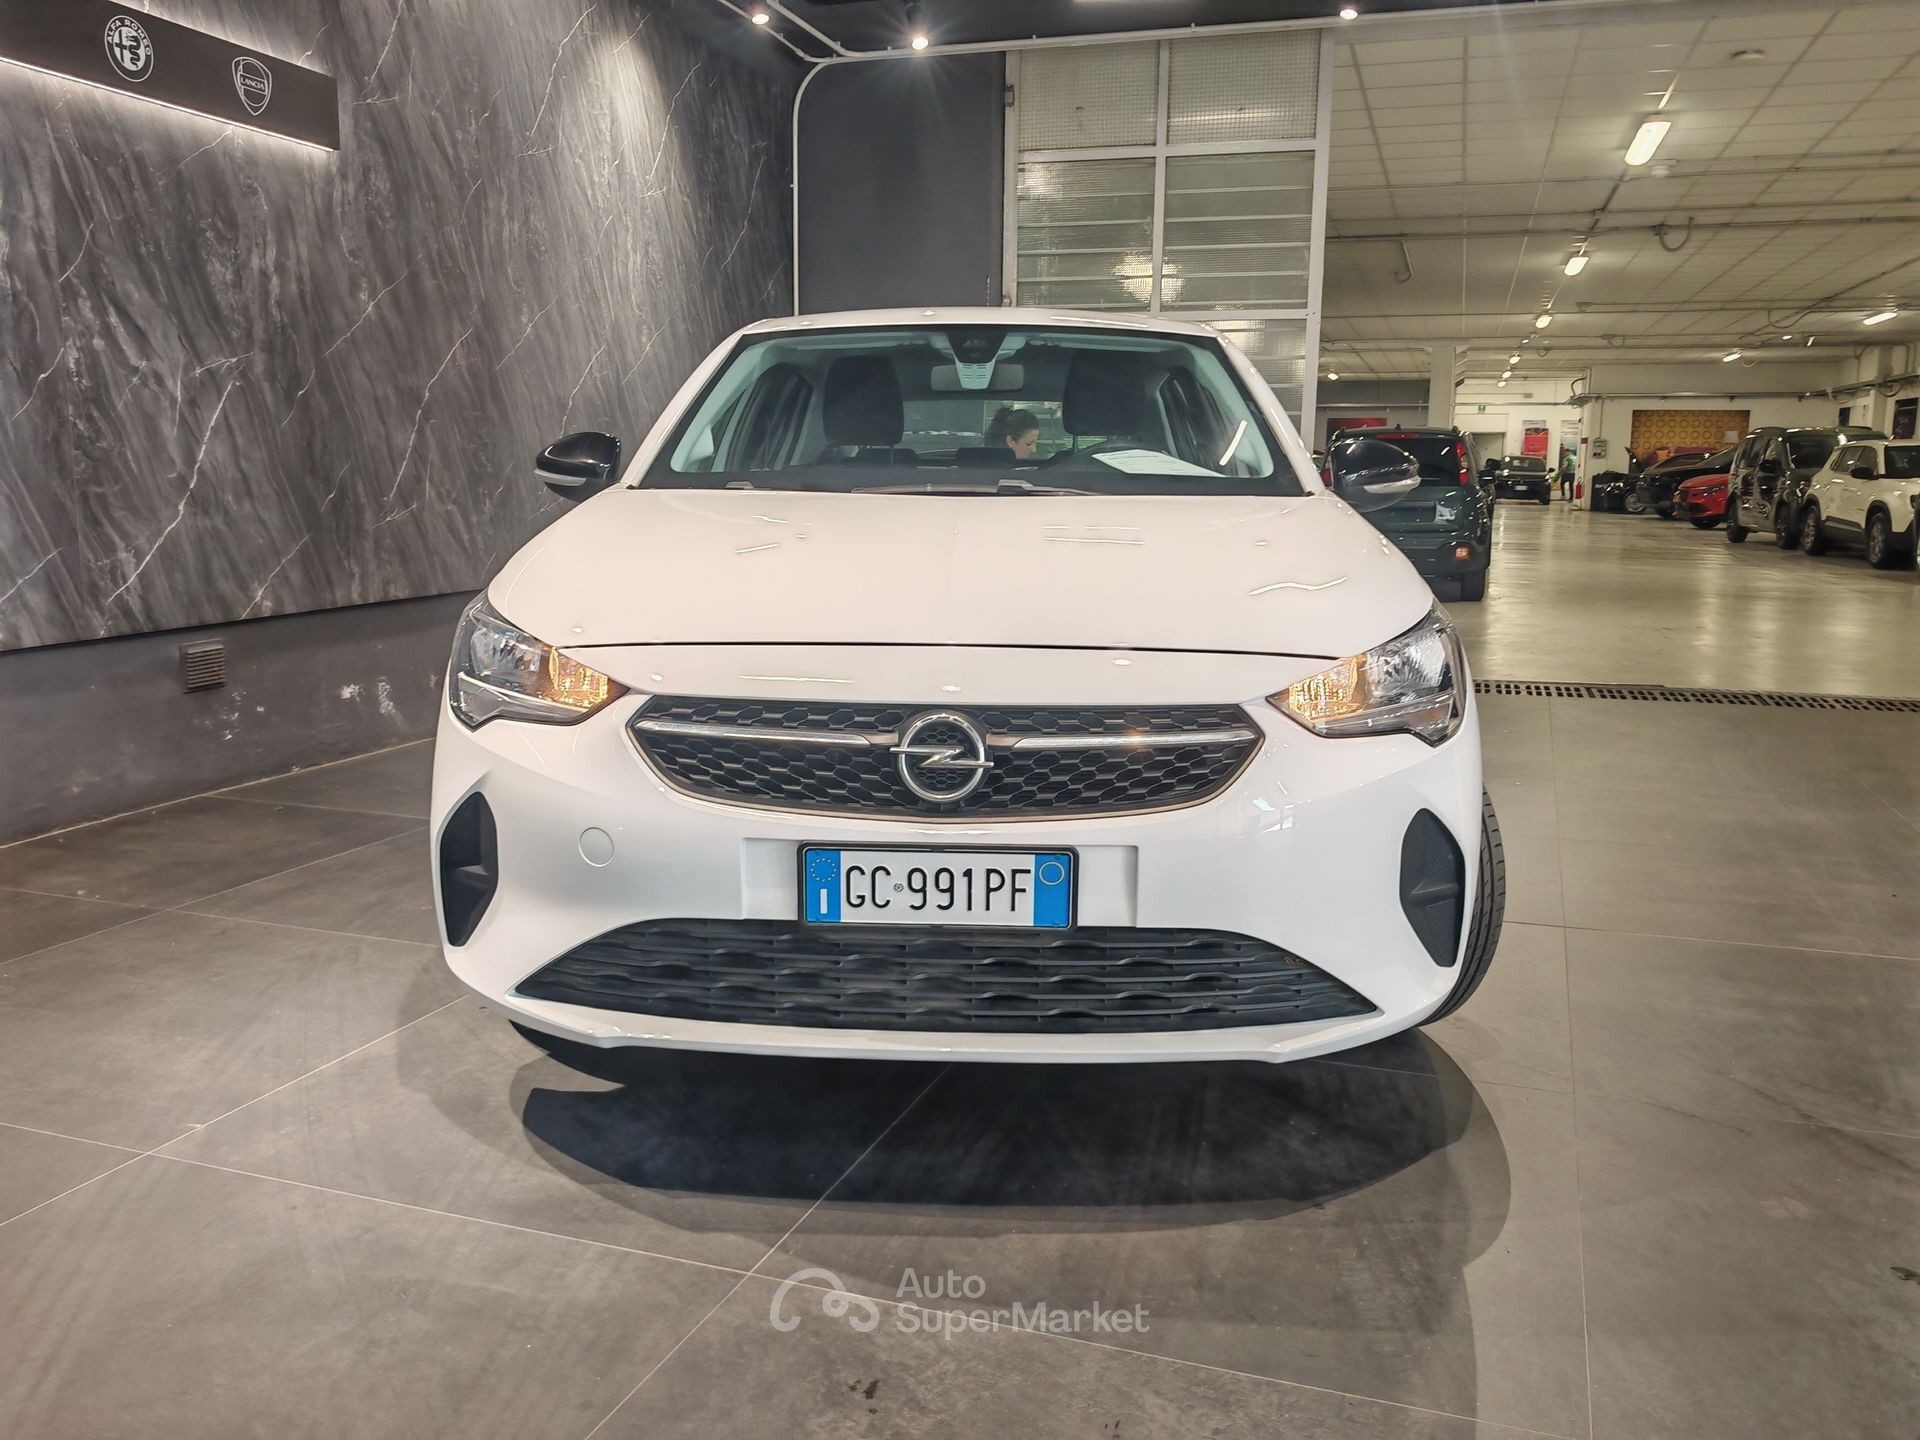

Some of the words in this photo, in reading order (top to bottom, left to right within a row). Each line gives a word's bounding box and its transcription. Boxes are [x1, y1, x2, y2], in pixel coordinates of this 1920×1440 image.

[107, 19, 122, 43] ALFA
[124, 19, 151, 55] ROMEO
[241, 76, 265, 90] LANCIA
